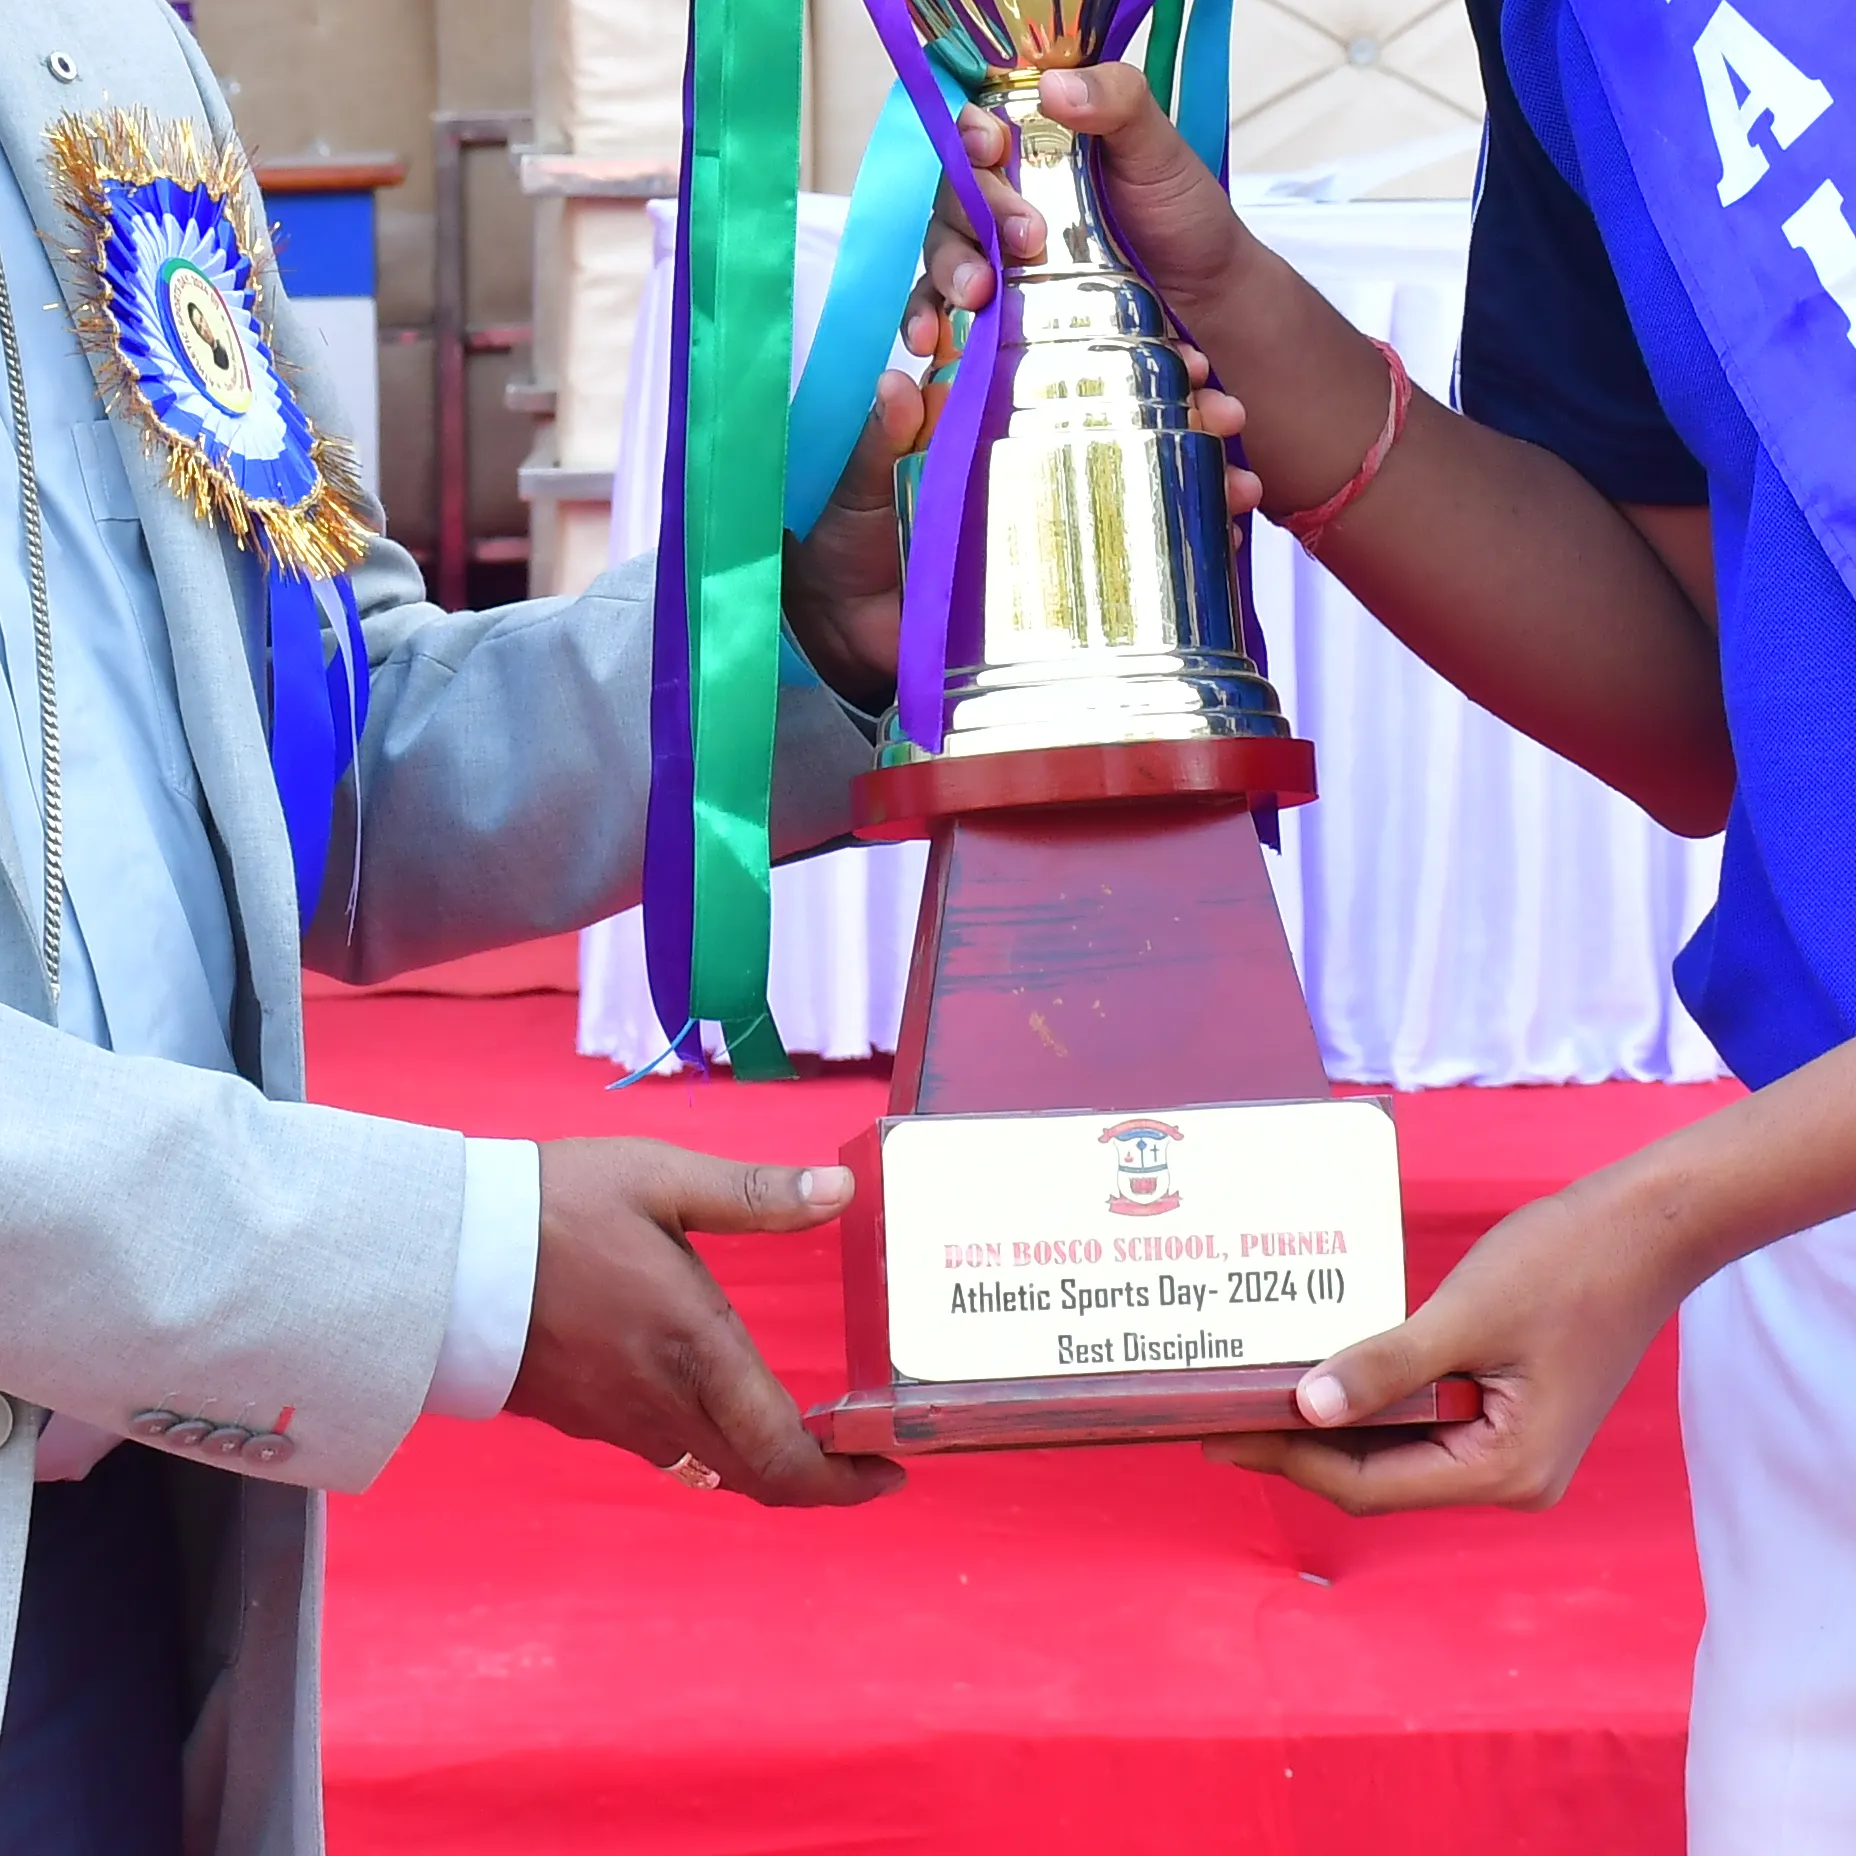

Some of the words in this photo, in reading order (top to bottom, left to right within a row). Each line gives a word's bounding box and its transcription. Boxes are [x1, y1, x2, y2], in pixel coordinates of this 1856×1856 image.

[944, 1243, 1001, 1269] DON
[1012, 1239, 1102, 1267] BOSCO
[1113, 1235, 1228, 1263] SCHOOL,
[1240, 1230, 1348, 1258] PURNEA
[951, 1281, 1051, 1314] Athletic
[1060, 1278, 1150, 1317] Sports
[1159, 1274, 1218, 1312] Day-
[1228, 1270, 1297, 1304] 2024
[1307, 1268, 1345, 1305] (II)
[1057, 1334, 1115, 1365] Best
[1123, 1329, 1244, 1367] Discipline
